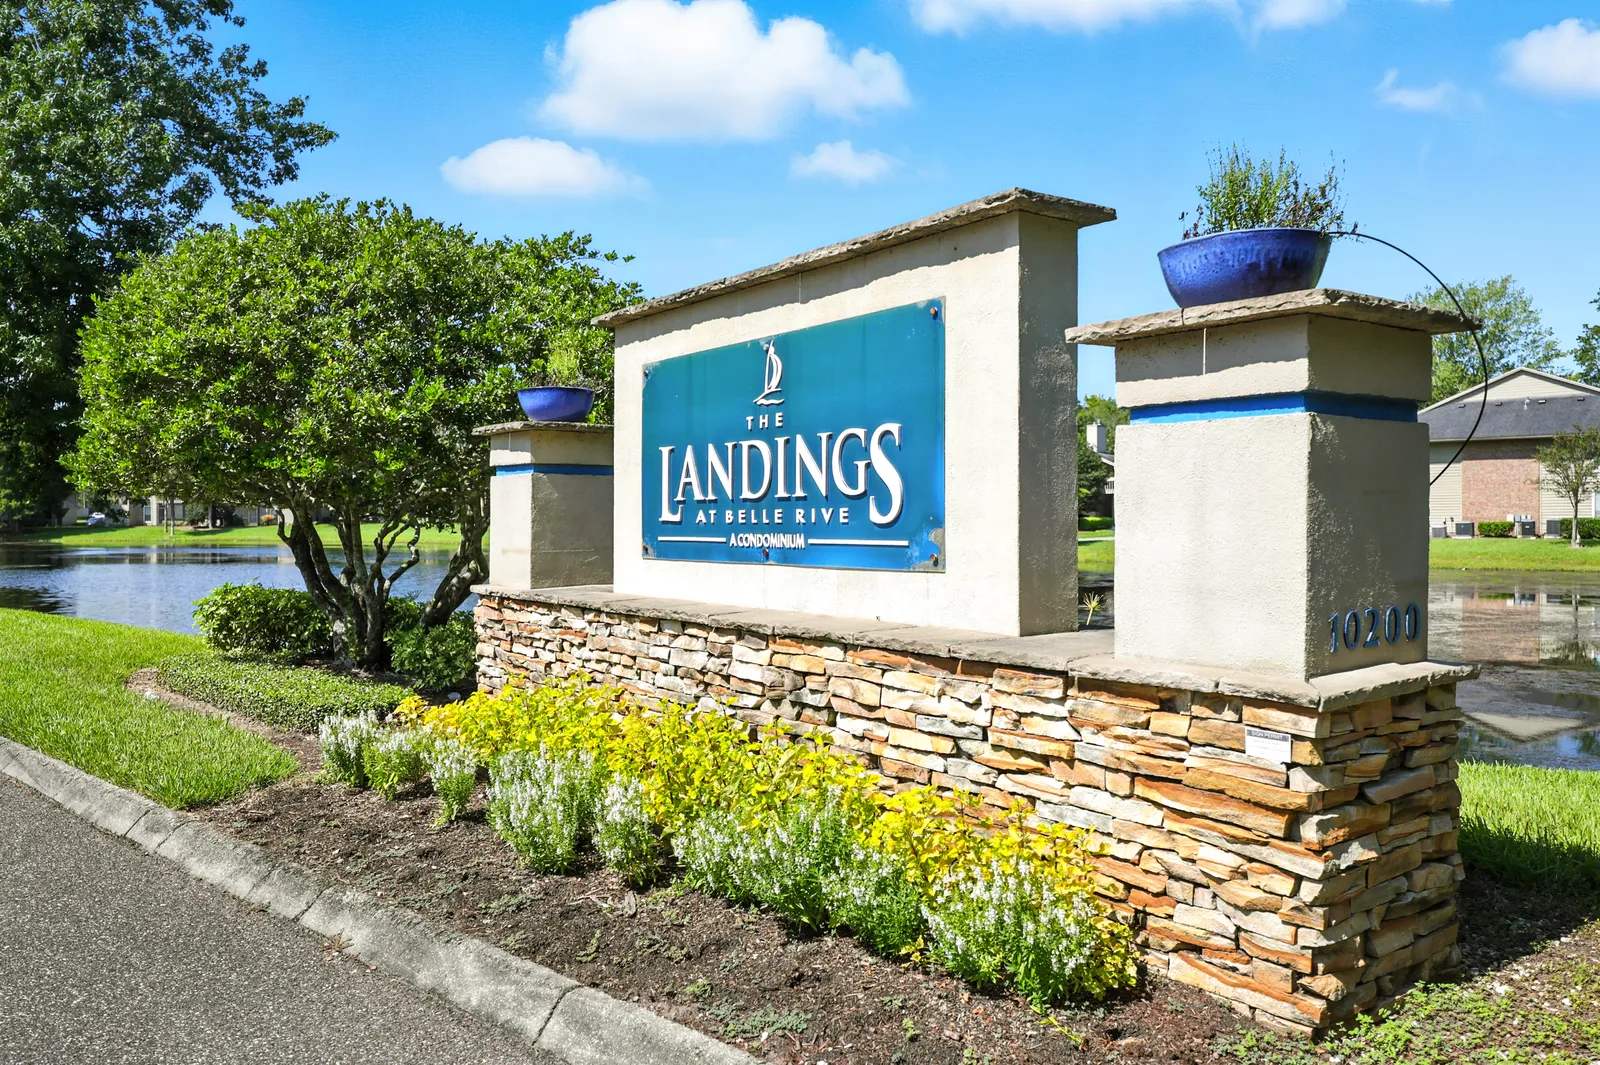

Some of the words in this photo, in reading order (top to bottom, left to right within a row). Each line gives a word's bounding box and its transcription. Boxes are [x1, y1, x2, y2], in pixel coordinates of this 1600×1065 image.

[746, 412, 784, 430] THE
[658, 422, 903, 525] LANDINGS
[696, 509, 716, 524] AT
[725, 508, 784, 524] BELLE
[795, 507, 850, 524] RIVE
[729, 532, 738, 547] A
[738, 532, 806, 549] CONDOMINIUM
[1327, 603, 1421, 653] 10200
